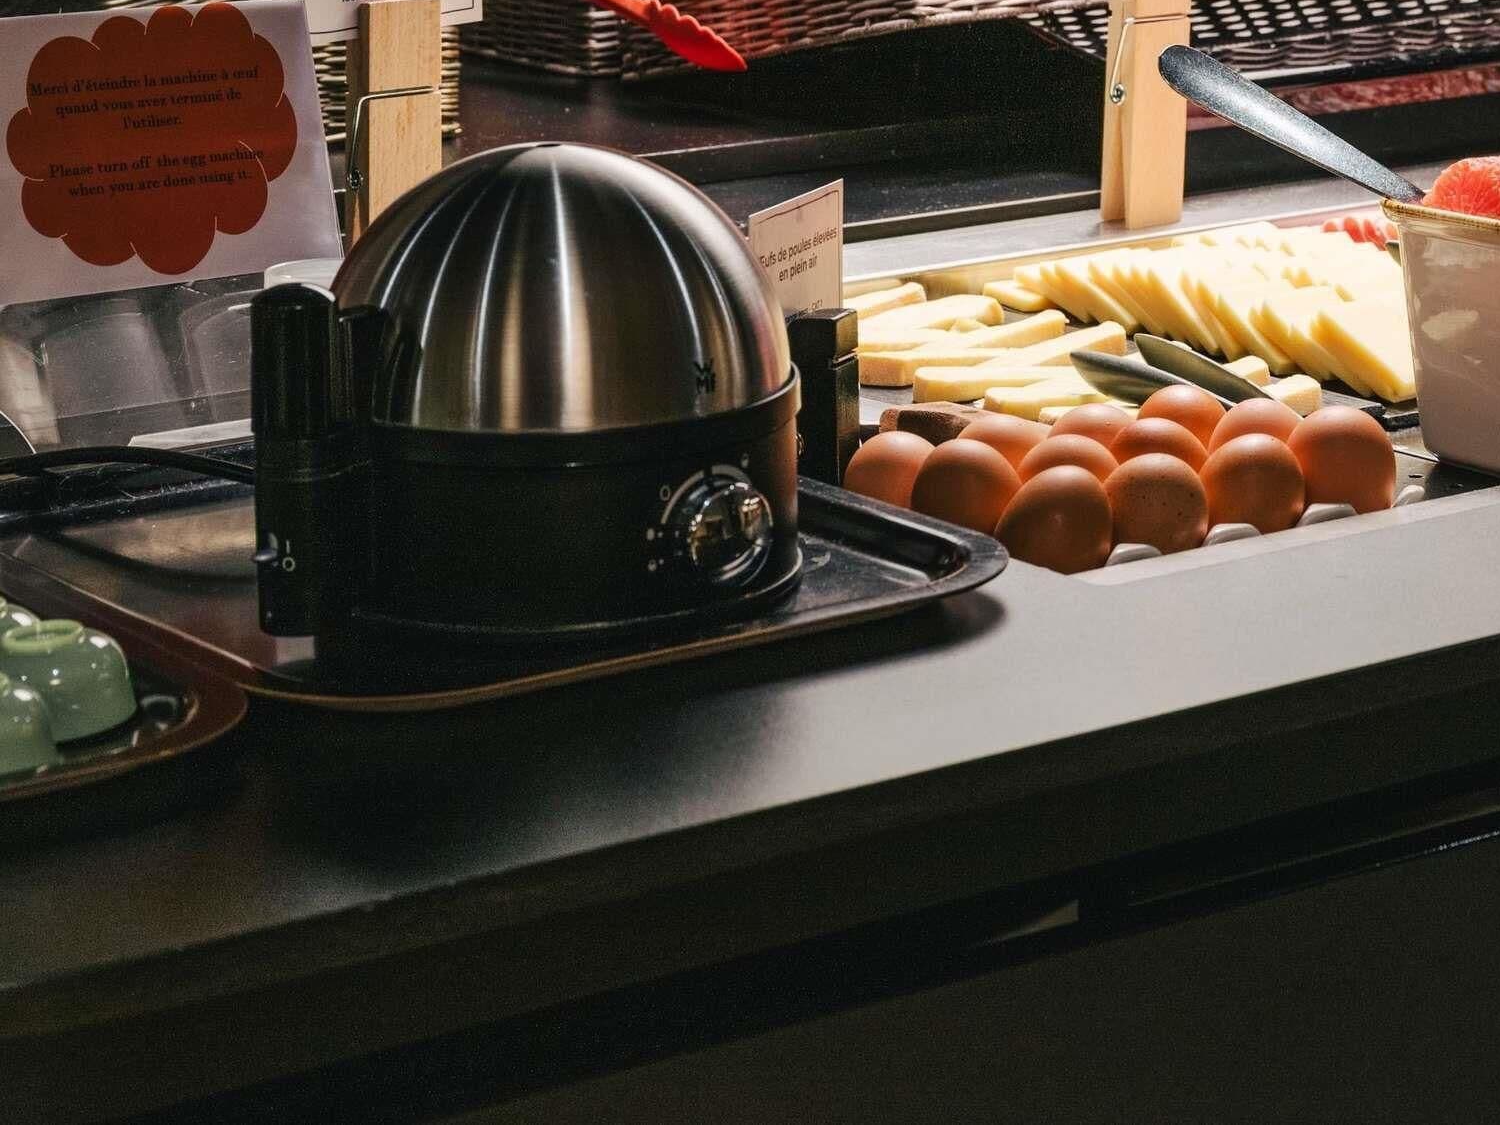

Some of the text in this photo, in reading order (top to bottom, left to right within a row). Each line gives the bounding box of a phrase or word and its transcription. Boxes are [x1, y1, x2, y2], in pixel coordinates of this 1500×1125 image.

[31, 82, 68, 96] Merci
[144, 75, 157, 87] la
[160, 71, 217, 84] machine
[55, 99, 98, 118] quand
[102, 100, 132, 110] vous
[137, 96, 165, 108] avez
[226, 87, 241, 100] de
[48, 148, 264, 178] Please turn off the egg machine
[69, 183, 104, 196] when
[110, 182, 133, 195] you
[138, 178, 160, 189] are
[163, 174, 196, 187] done
[198, 171, 234, 185] using
[778, 249, 787, 262] de
[788, 237, 812, 259] poules
[779, 253, 818, 282] en plein air
